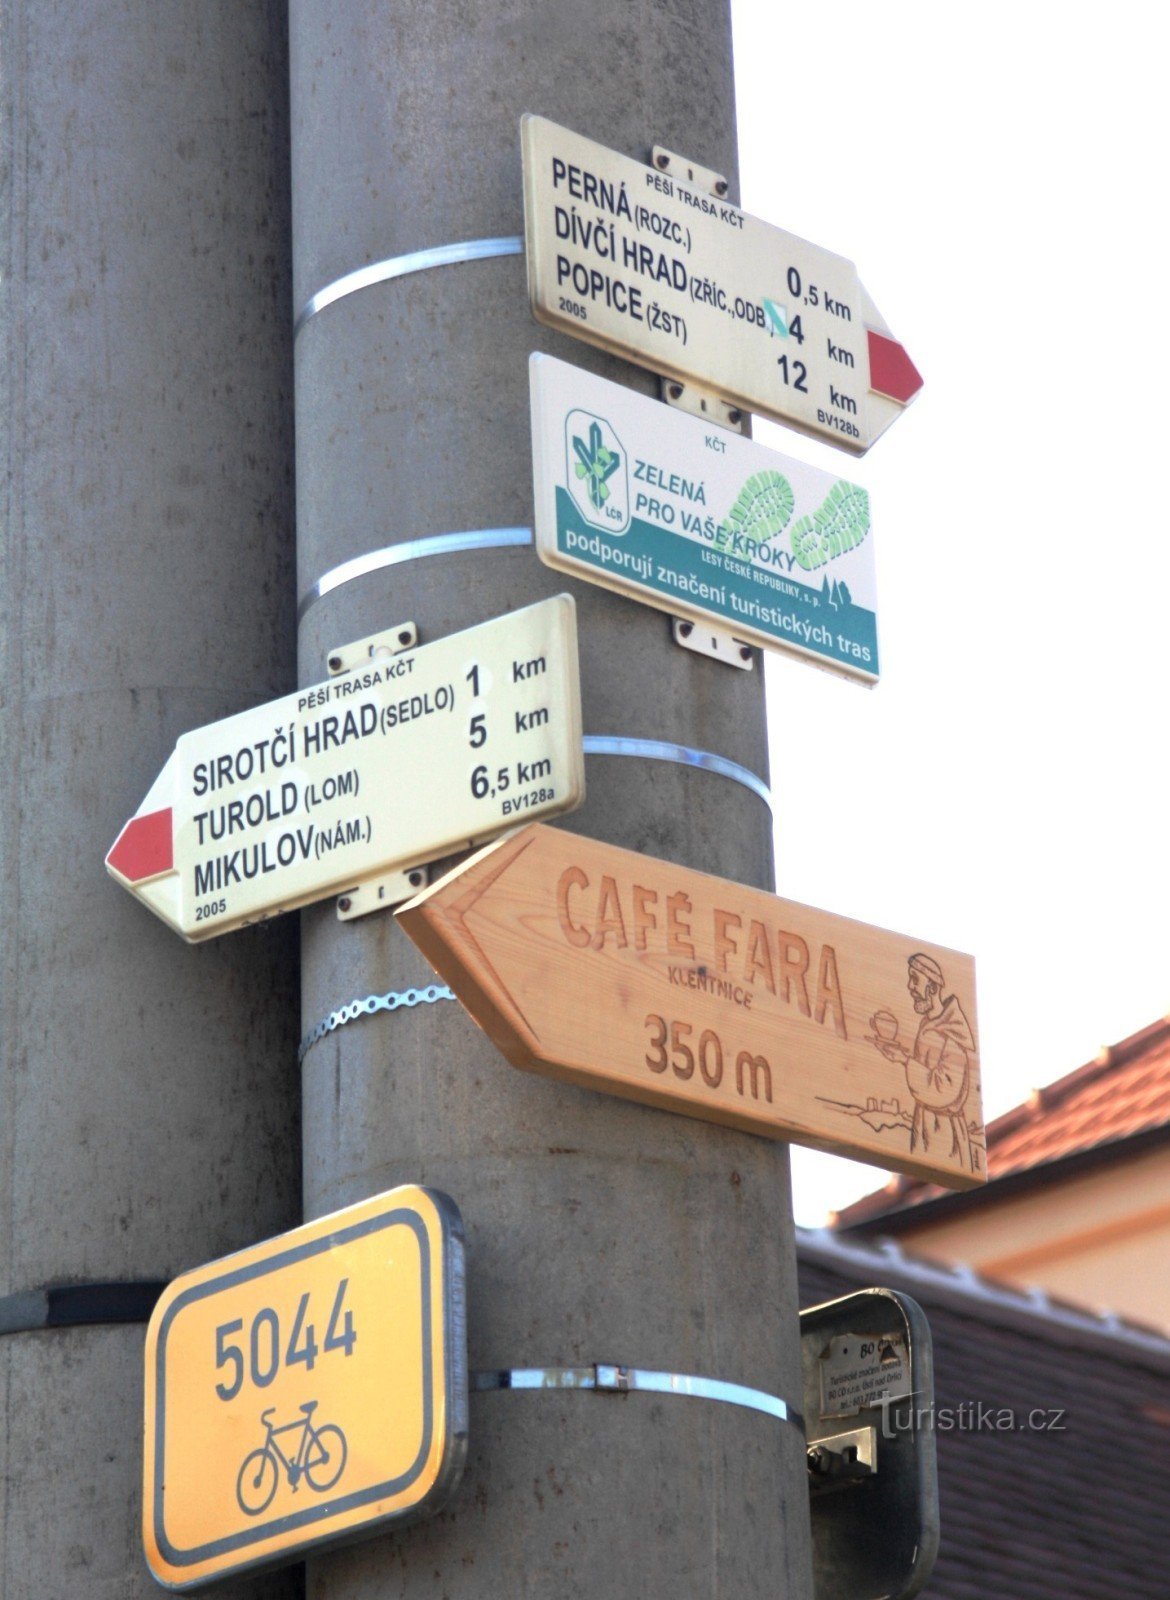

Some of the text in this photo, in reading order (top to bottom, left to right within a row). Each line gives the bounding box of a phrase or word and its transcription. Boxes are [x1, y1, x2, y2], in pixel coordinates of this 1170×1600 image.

[552, 157, 851, 321] PERNÁ (ROZC.) 0,5 km
[646, 174, 745, 230] PĚŠÍ TRASA KČT
[555, 206, 616, 261] DÍVČÍ
[623, 237, 688, 292] HRAD
[789, 314, 804, 345] 4
[827, 338, 854, 368] km
[559, 297, 587, 320] 2005
[557, 255, 857, 415] POPICE (ŽST) 12 km
[704, 435, 727, 454] KČT
[817, 409, 860, 438] BV128b
[633, 459, 706, 506] ZELENÁ
[636, 493, 797, 572] PRO VAŠE KROKY
[701, 550, 722, 568] LESY
[724, 556, 751, 580] ČESKÉ
[566, 530, 871, 662] podporují značení turistických tras
[298, 658, 414, 712] PĚŠÍ TRASA KČT
[193, 656, 546, 797] SIROTČÍ HRAD (SEDLO) 1 km
[193, 707, 549, 846] TUROLD (LOM) 5 km
[502, 788, 555, 815] BV128a
[194, 758, 551, 897] MIKULOV (NÁM.) 6,5 km
[195, 898, 227, 921] 2005
[557, 866, 848, 1041] CAFÉ FARA
[668, 966, 753, 1010] KLENTNICE
[645, 1014, 773, 1103] 350 m
[215, 1277, 357, 1402] 5044
